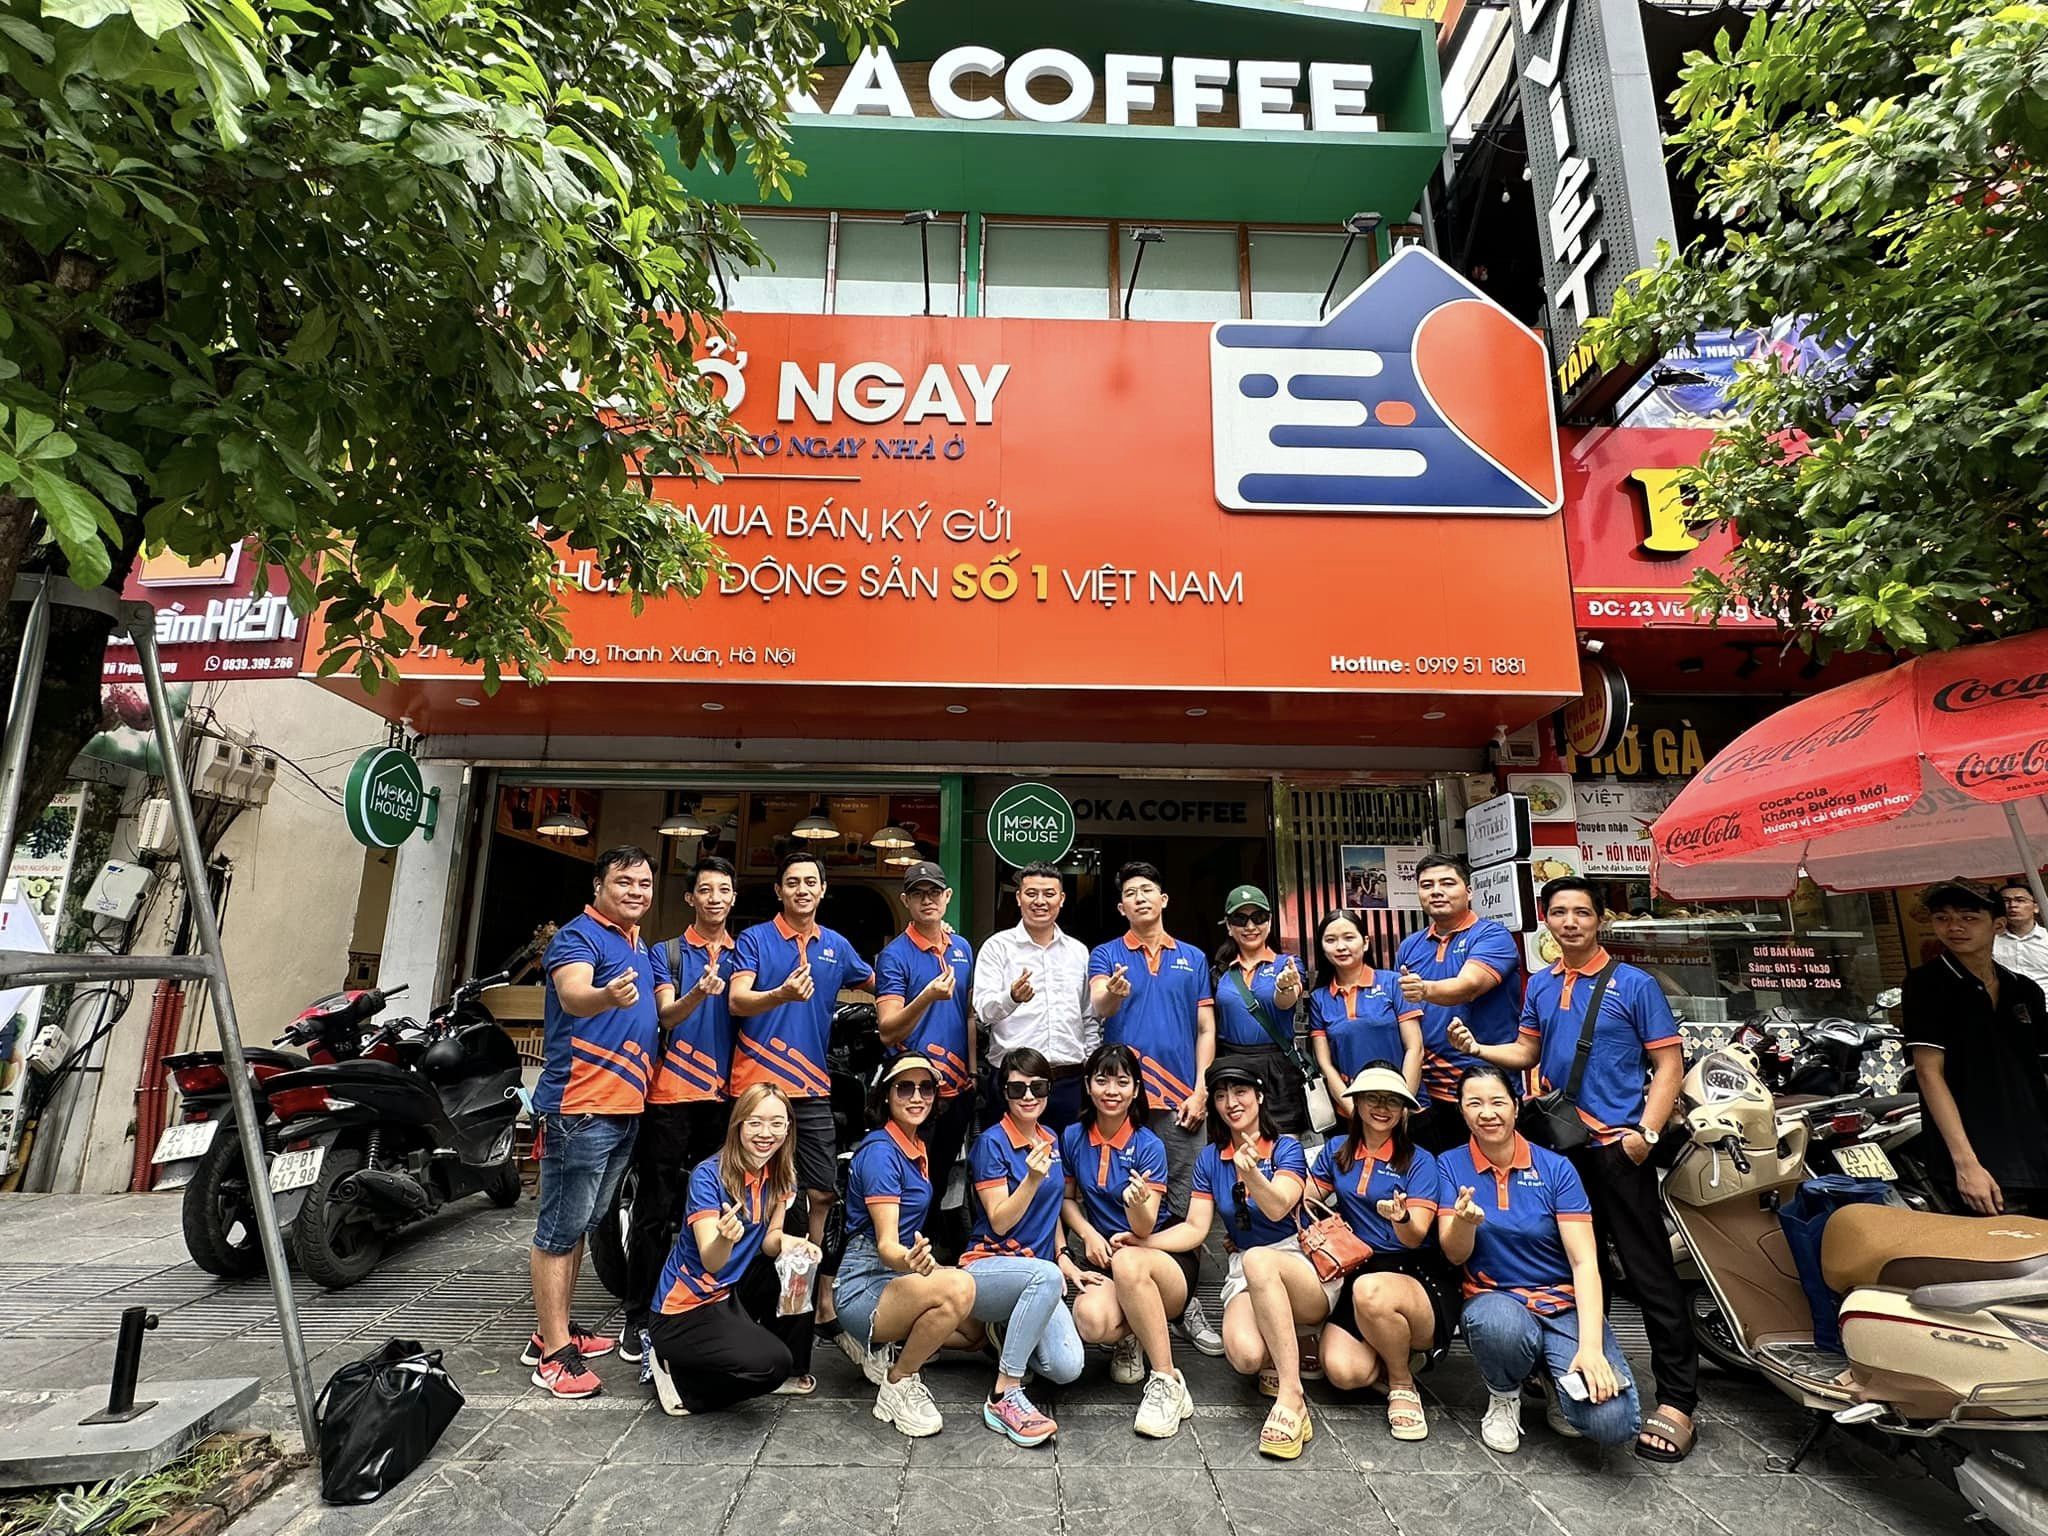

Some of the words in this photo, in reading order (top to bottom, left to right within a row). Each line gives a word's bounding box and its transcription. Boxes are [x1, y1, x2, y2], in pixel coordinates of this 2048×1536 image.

[927, 45, 1379, 133] COFFEE
[777, 360, 1011, 426] NGAY
[787, 435, 866, 459] NGAY
[685, 502, 774, 537] MUA
[881, 498, 931, 542] KÝ
[943, 498, 1012, 544] GỬI
[858, 556, 939, 603] SẢN
[950, 549, 1022, 604] SỐ
[1031, 565, 1048, 603] 1
[1061, 560, 1140, 607] VIỆT
[1148, 571, 1244, 605] NAM
[1629, 601, 1654, 617] 23
[606, 644, 662, 663] Thanh
[670, 645, 723, 668] Xuân,
[730, 645, 756, 663] Hà
[764, 644, 796, 668] Nội
[1330, 655, 1411, 674] Hotline:
[1415, 655, 1459, 674] 0919
[1463, 656, 1482, 675] 51
[1488, 657, 1527, 675] 1881
[1652, 719, 1706, 775] GÀ
[377, 781, 414, 807] MOKA
[1759, 786, 1829, 812] Coca-Cola
[374, 798, 412, 821] HOUSE
[1072, 798, 1136, 821] OKA
[1139, 799, 1248, 824] COFFEE
[1760, 805, 1805, 825] Không
[1763, 820, 1798, 836] Hương
[1852, 800, 1882, 815] ngon
[1004, 815, 1059, 830] MOKA
[1666, 811, 1743, 855] Coca-Cola
[1003, 830, 1059, 843] HOUSE
[1481, 889, 1501, 909] Spa
[1774, 963, 1796, 974] 6h15
[1804, 963, 1831, 974] 14h30
[1780, 978, 1807, 989] 16h30
[1815, 978, 1841, 989] 22h45
